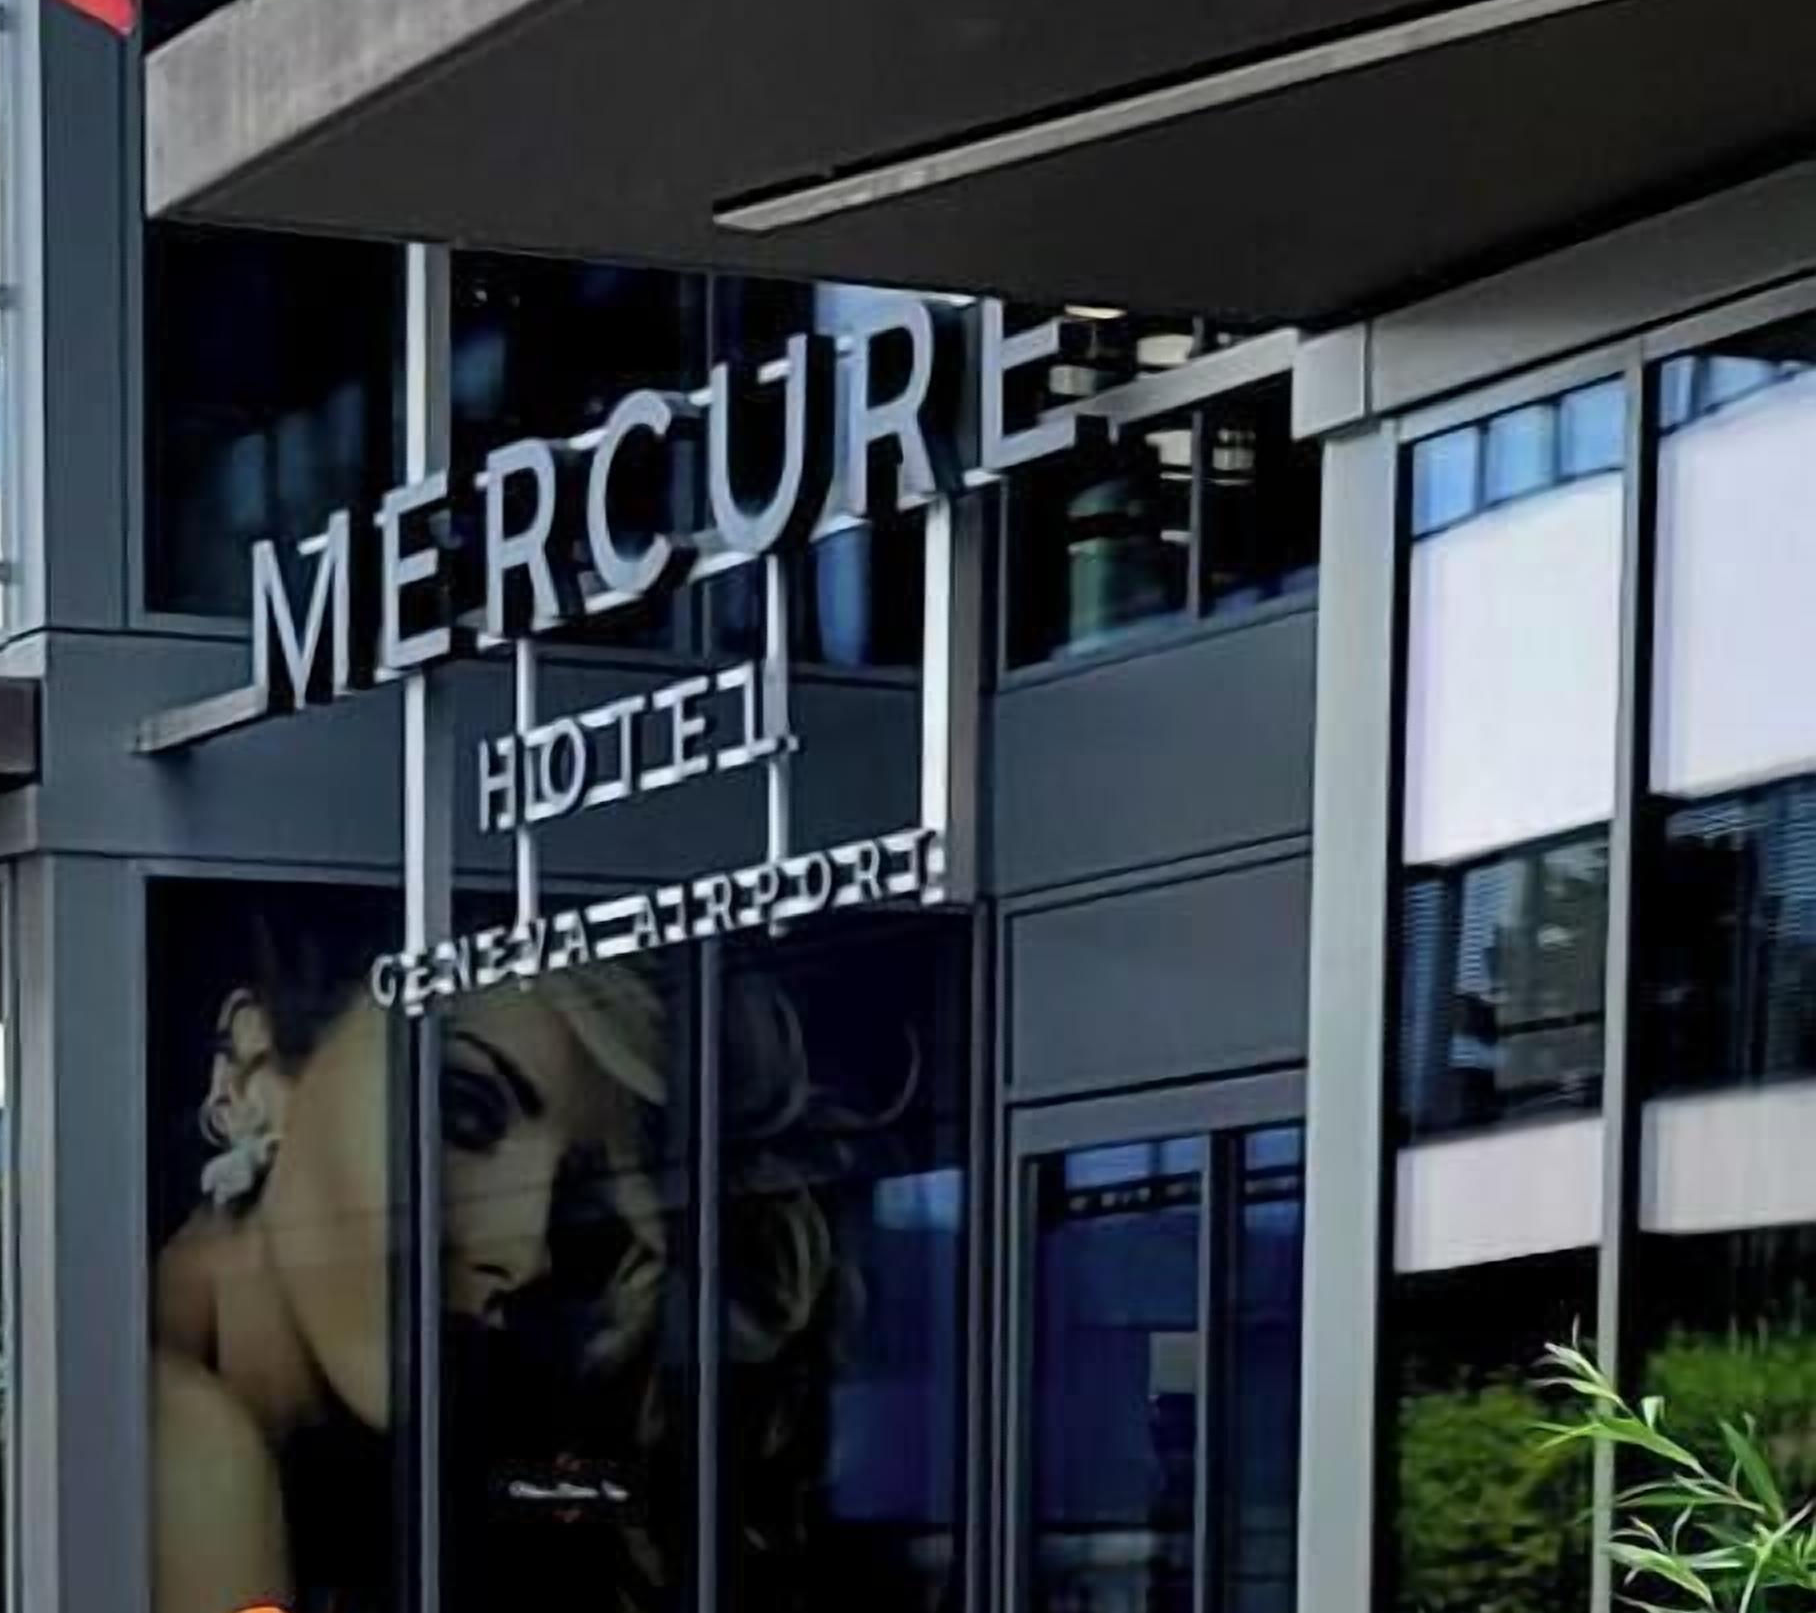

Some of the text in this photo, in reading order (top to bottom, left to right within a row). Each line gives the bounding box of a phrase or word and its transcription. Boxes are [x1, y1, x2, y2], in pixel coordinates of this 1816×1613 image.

[251, 297, 1077, 710] MERCURE
[478, 661, 780, 833] HOTEL
[370, 828, 946, 1011] GENEVA AIRPORT
